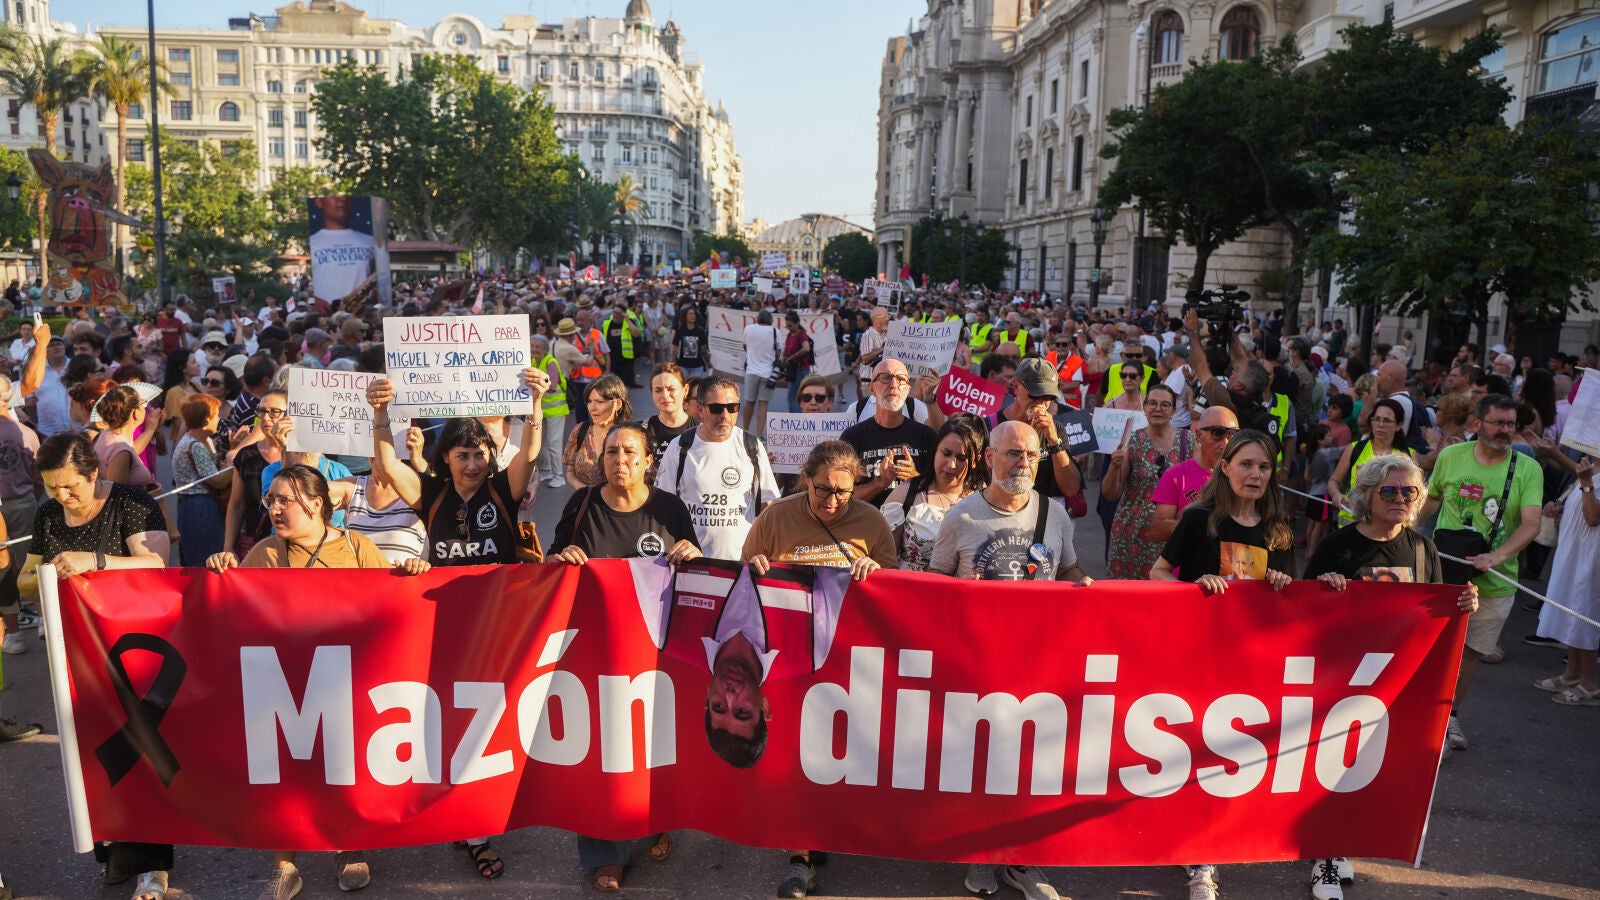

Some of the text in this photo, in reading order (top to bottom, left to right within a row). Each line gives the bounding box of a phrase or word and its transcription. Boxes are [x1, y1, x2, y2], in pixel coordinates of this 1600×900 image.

[401, 320, 520, 342] JUSTICIA PARA
[901, 325, 952, 337] JUSTICIA
[387, 347, 524, 367] MIGUEL Y SARA CARPIO
[453, 372, 460, 382] E
[332, 391, 361, 403] PARA
[392, 391, 398, 403] Y
[406, 391, 443, 403] TODAS
[449, 391, 470, 402] LAS
[949, 374, 996, 406] Volem
[288, 401, 369, 419] MIGUEL Y SARA
[311, 419, 345, 434] PADRE
[355, 423, 361, 435] E
[769, 418, 776, 430] C
[780, 417, 816, 431] MAZÓN
[768, 433, 820, 447] RESPONSABLE
[702, 493, 728, 506] 228
[729, 505, 743, 516] PER
[700, 518, 739, 527] LLUITAR
[435, 538, 499, 559] SARA
[794, 545, 810, 554] 230
[239, 628, 1395, 798] Mazón dimissió
